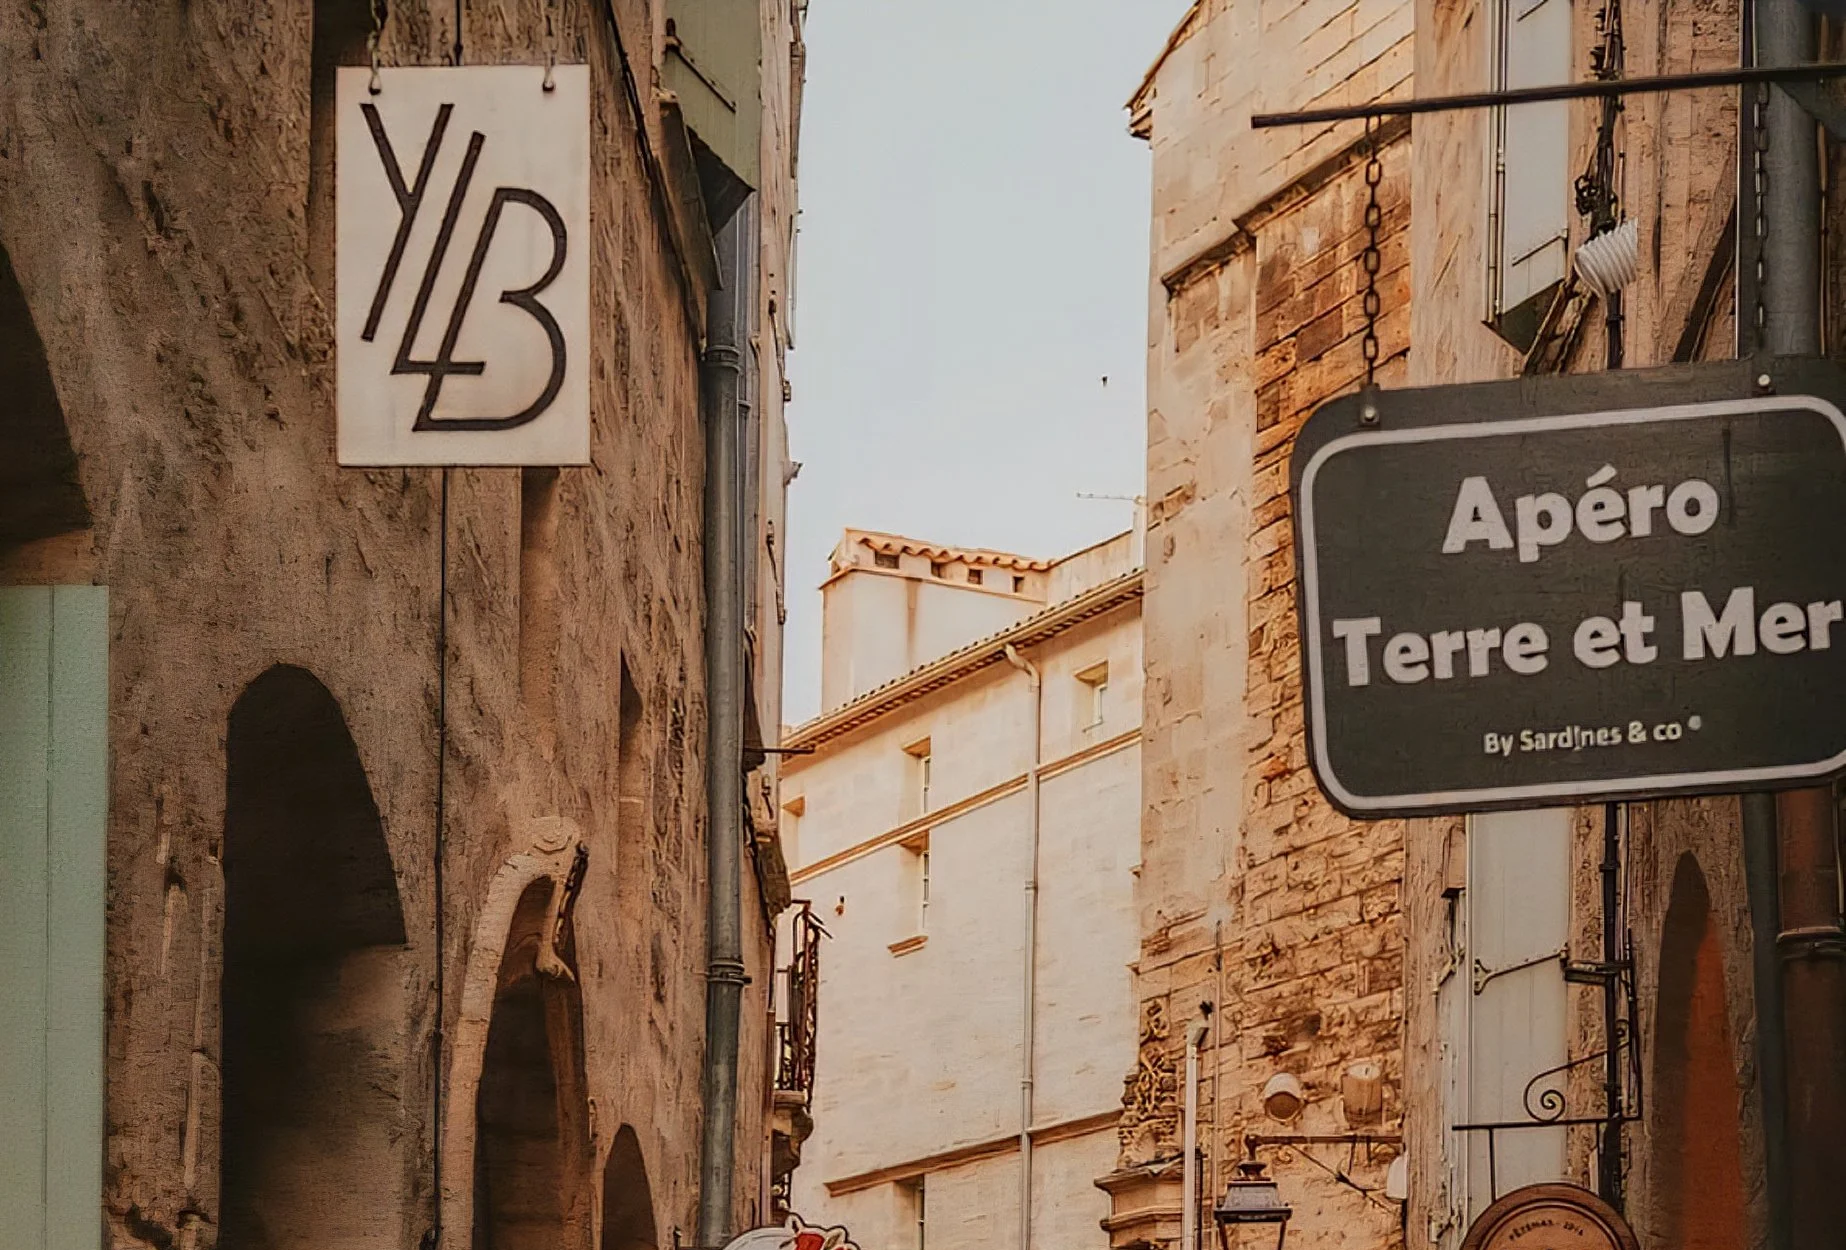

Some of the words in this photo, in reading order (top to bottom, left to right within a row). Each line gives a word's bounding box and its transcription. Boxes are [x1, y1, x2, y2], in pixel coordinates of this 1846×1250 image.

[1441, 463, 1720, 562] Apéro
[1333, 617, 1549, 687] Terre
[1573, 601, 1659, 668] et
[1681, 586, 1843, 660] Mer
[1484, 732, 1514, 756] By
[1628, 720, 1647, 743] &
[1653, 723, 1682, 741] co
